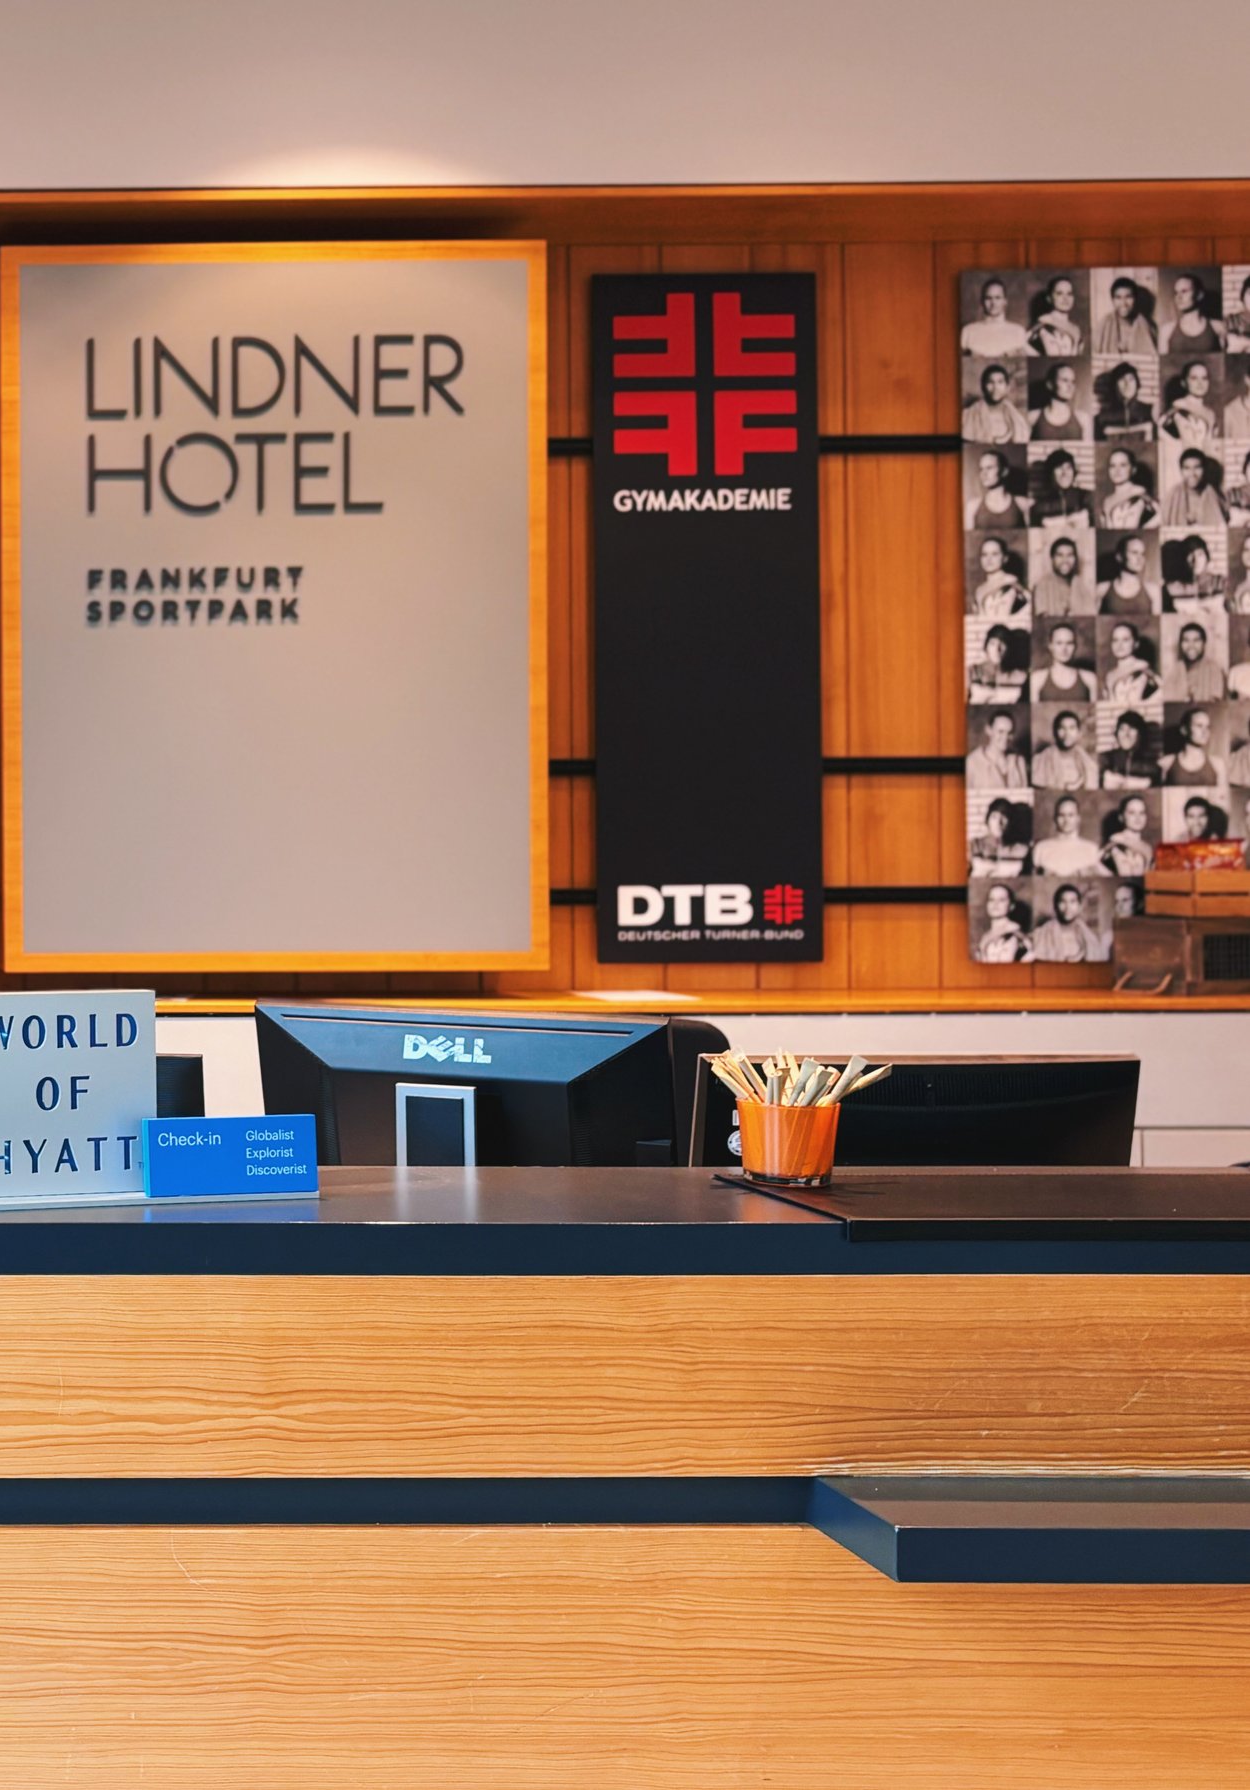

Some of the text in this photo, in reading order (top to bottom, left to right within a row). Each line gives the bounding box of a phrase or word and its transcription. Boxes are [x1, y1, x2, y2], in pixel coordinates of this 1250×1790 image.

[86, 333, 465, 420] LINDNER
[86, 431, 385, 516] HOTEL
[613, 488, 793, 512] GYMAKADEMIE
[86, 566, 305, 593] FRANKFURT
[86, 598, 301, 626] SPORTPARK
[617, 884, 754, 926] DTB
[617, 930, 700, 941] DEUTSCHER
[403, 1034, 492, 1064] DELL
[36, 1075, 90, 1111] OF
[158, 1132, 222, 1147] Check-in
[245, 1129, 295, 1142] Globalist
[246, 1147, 294, 1160] Explorist
[246, 1164, 308, 1176] Discoverist
